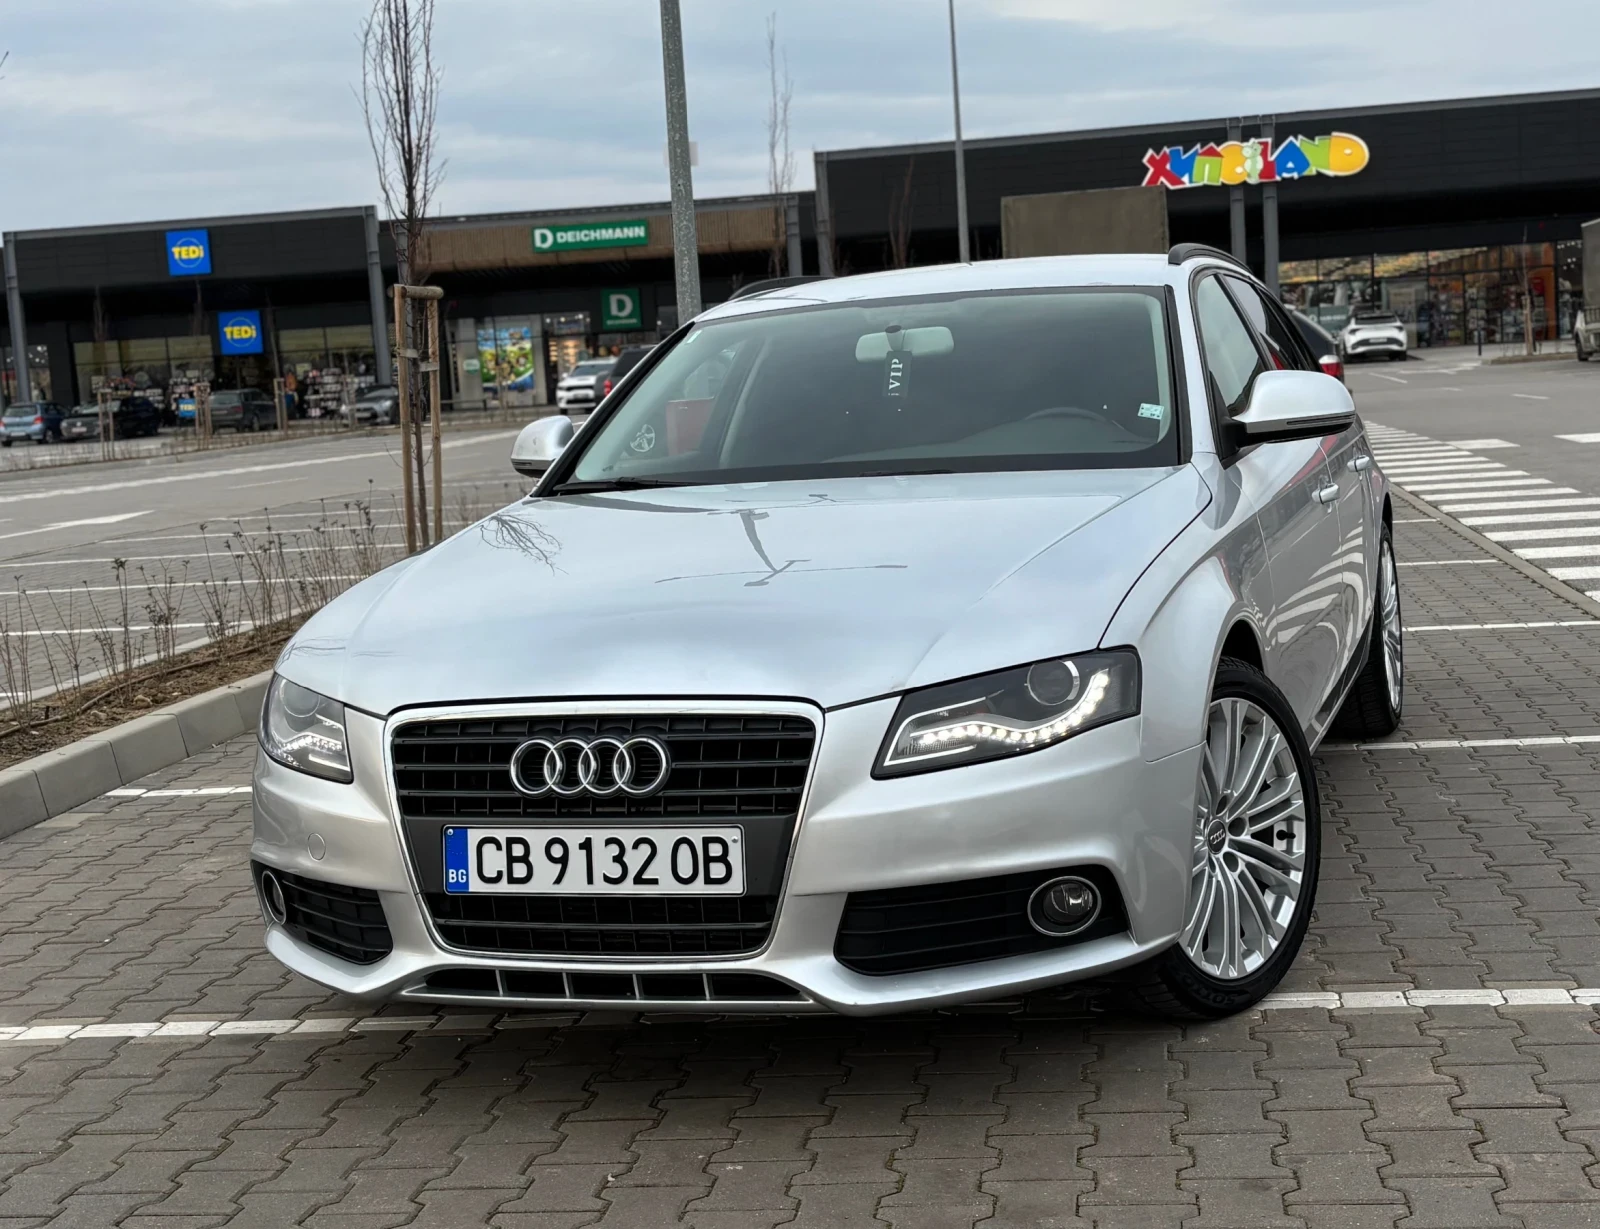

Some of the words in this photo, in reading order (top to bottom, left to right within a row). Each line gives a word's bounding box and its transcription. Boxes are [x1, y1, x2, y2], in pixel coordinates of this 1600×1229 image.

[533, 228, 554, 249] D
[556, 226, 645, 243] DEICHMANN
[171, 245, 204, 260] TEDi
[609, 294, 633, 317] D
[223, 325, 257, 340] TEDi
[889, 358, 903, 390] VIP
[476, 836, 534, 885] CB
[544, 836, 660, 886] 9132
[448, 869, 467, 884] BG
